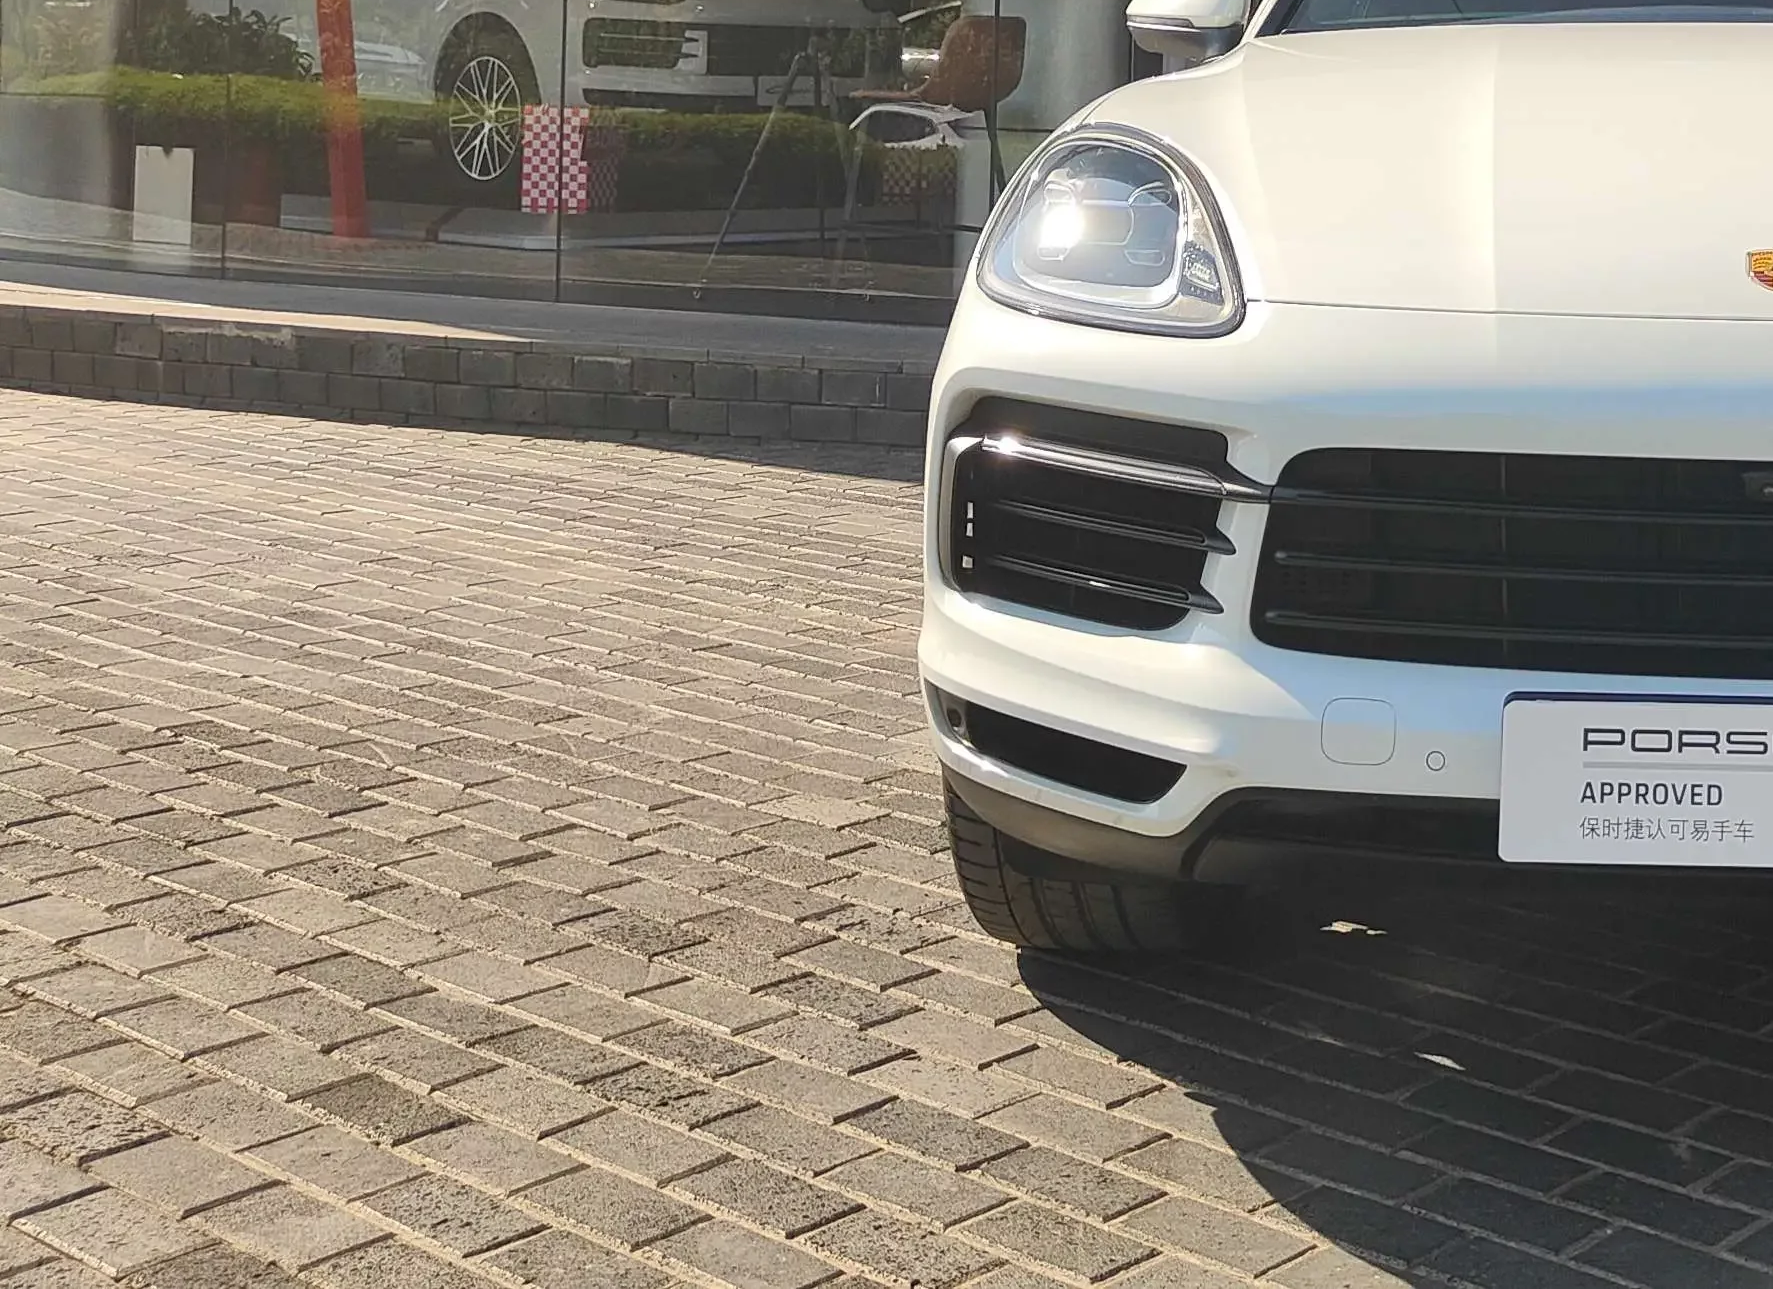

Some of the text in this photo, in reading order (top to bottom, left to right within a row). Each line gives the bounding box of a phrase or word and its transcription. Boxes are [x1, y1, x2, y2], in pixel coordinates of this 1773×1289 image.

[1580, 781, 1723, 806] APPROVED
[1579, 816, 1755, 843] 保时捷认可易手车
